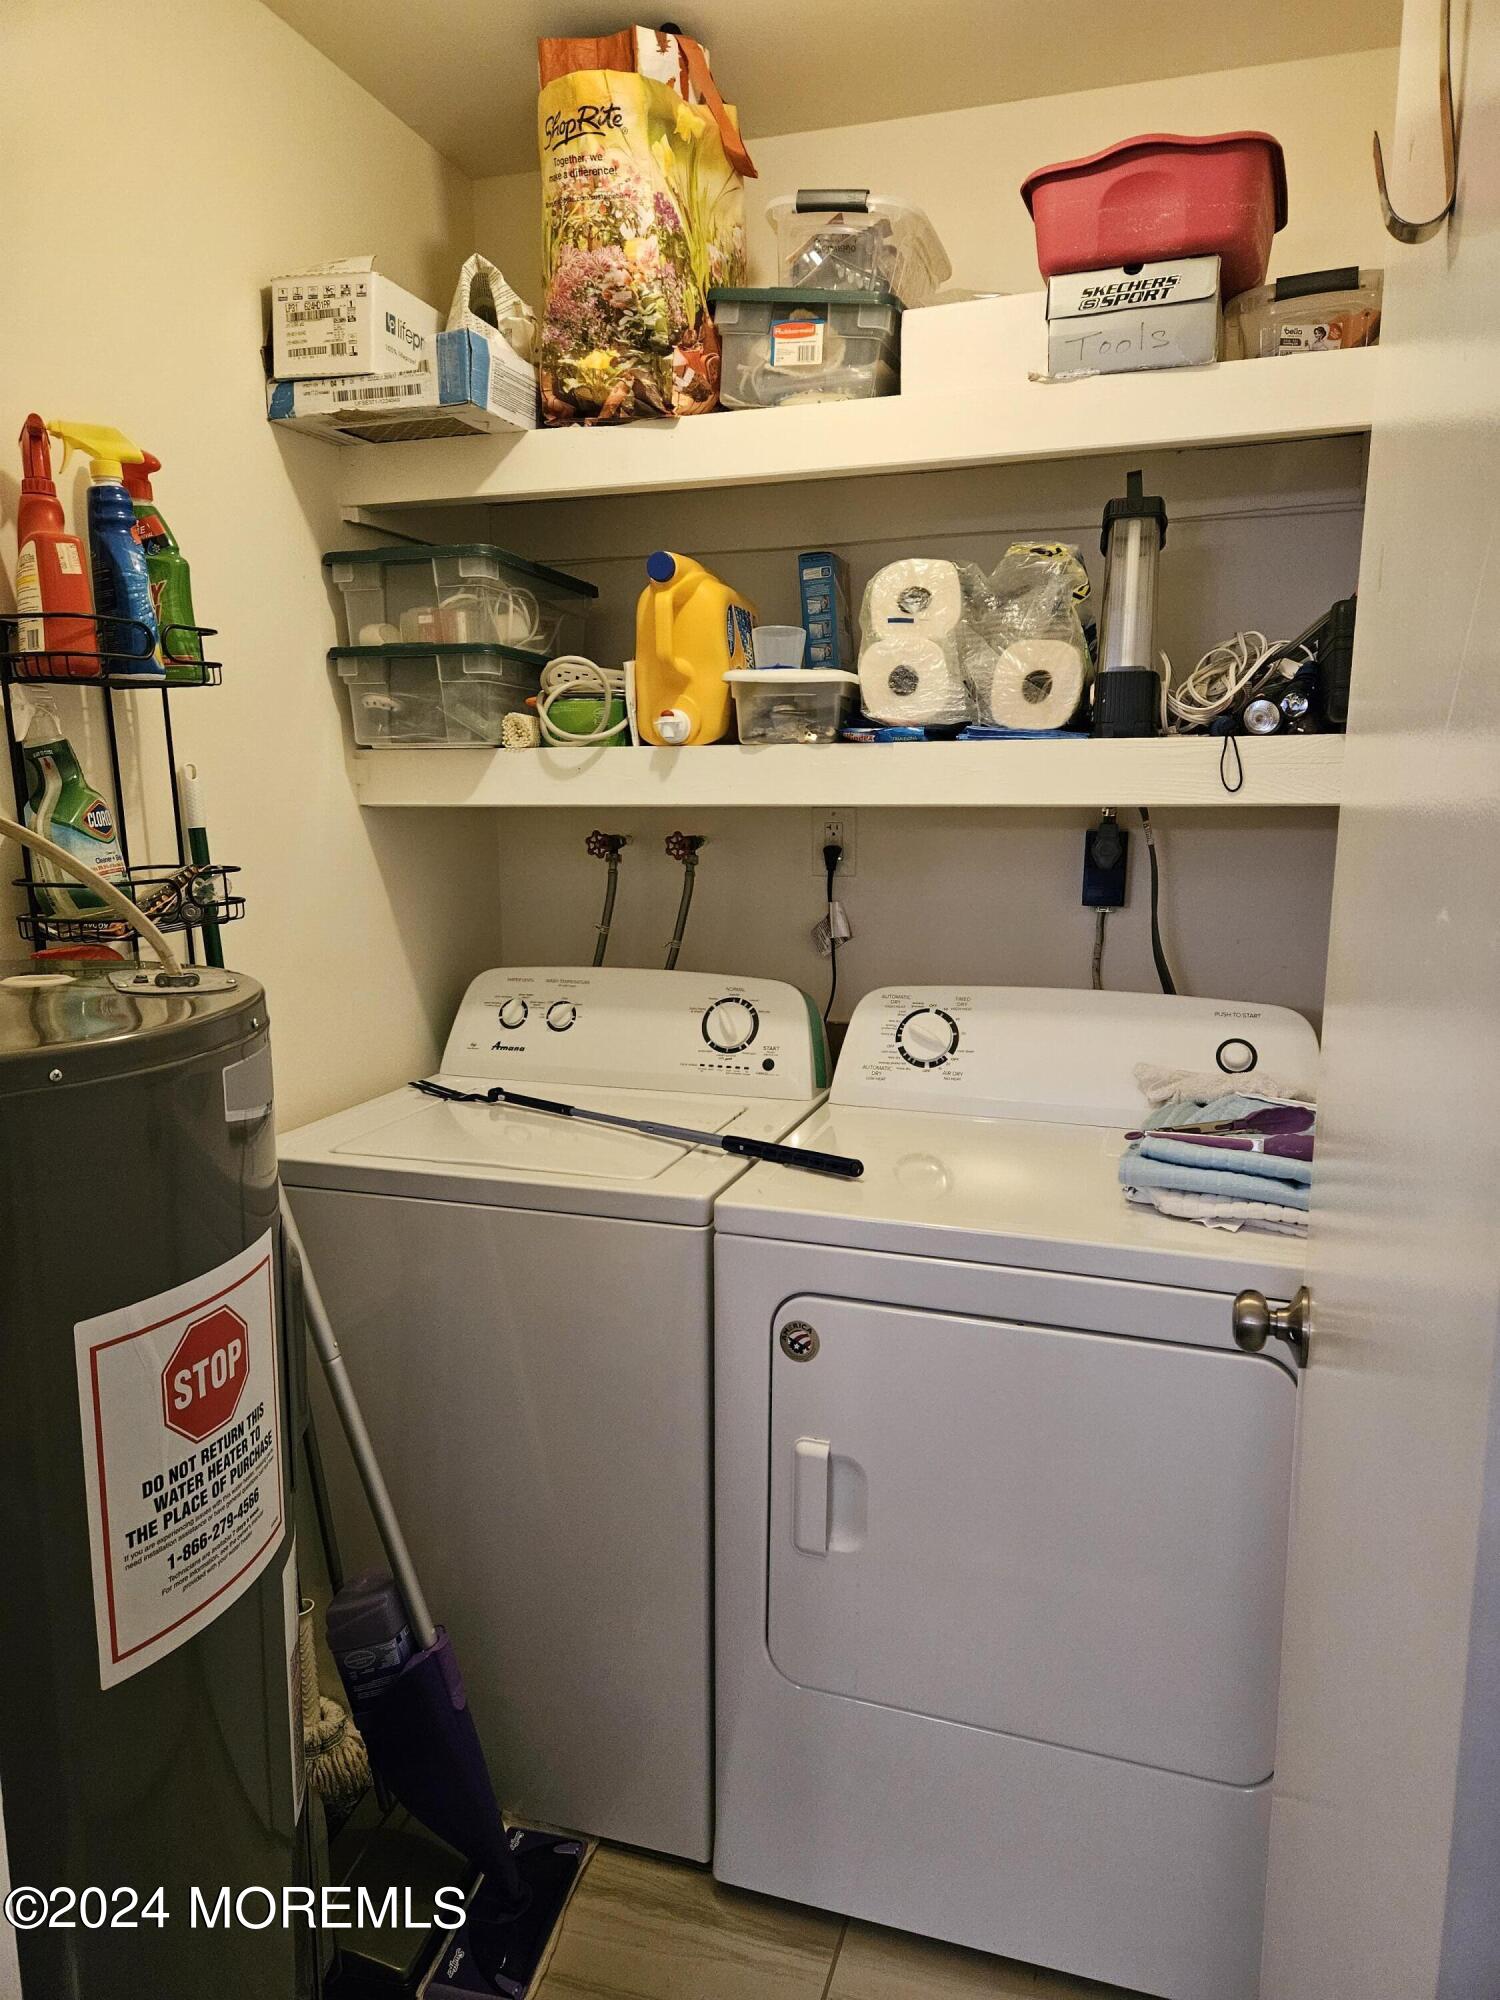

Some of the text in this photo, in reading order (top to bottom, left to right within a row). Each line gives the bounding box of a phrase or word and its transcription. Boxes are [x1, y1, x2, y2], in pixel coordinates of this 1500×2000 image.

[544, 103, 623, 151] ShopRite
[569, 166, 618, 178] difference!
[1081, 275, 1180, 298] SKECHERS
[1065, 322, 1169, 360] Tools
[1284, 327, 1303, 335] bella
[491, 1041, 525, 1052] Amana
[781, 1322, 813, 1341] AMERICA
[174, 1338, 241, 1410] STOP
[142, 1474, 164, 1499] DO
[168, 1455, 196, 1485] NOT
[201, 1421, 244, 1466] RETURN
[246, 1402, 264, 1430] THIS
[154, 1471, 204, 1513] WATER
[208, 1438, 248, 1481] HEATER
[250, 1425, 261, 1446] TO
[125, 1519, 158, 1549] THE
[163, 1489, 208, 1530] PLACE
[212, 1475, 226, 1498] OF
[230, 1430, 272, 1485] PURCHASE
[125, 1558, 142, 1571] need
[144, 1539, 177, 1561] installation
[178, 1519, 207, 1541] assistance
[131, 1549, 143, 1560] you
[144, 1542, 156, 1552] are
[157, 1519, 194, 1545] experiencing
[167, 1487, 259, 1570] 1-866-279-4566
[161, 1586, 172, 1596] For
[173, 1575, 188, 1589] more
[168, 1558, 201, 1582] Technicians
